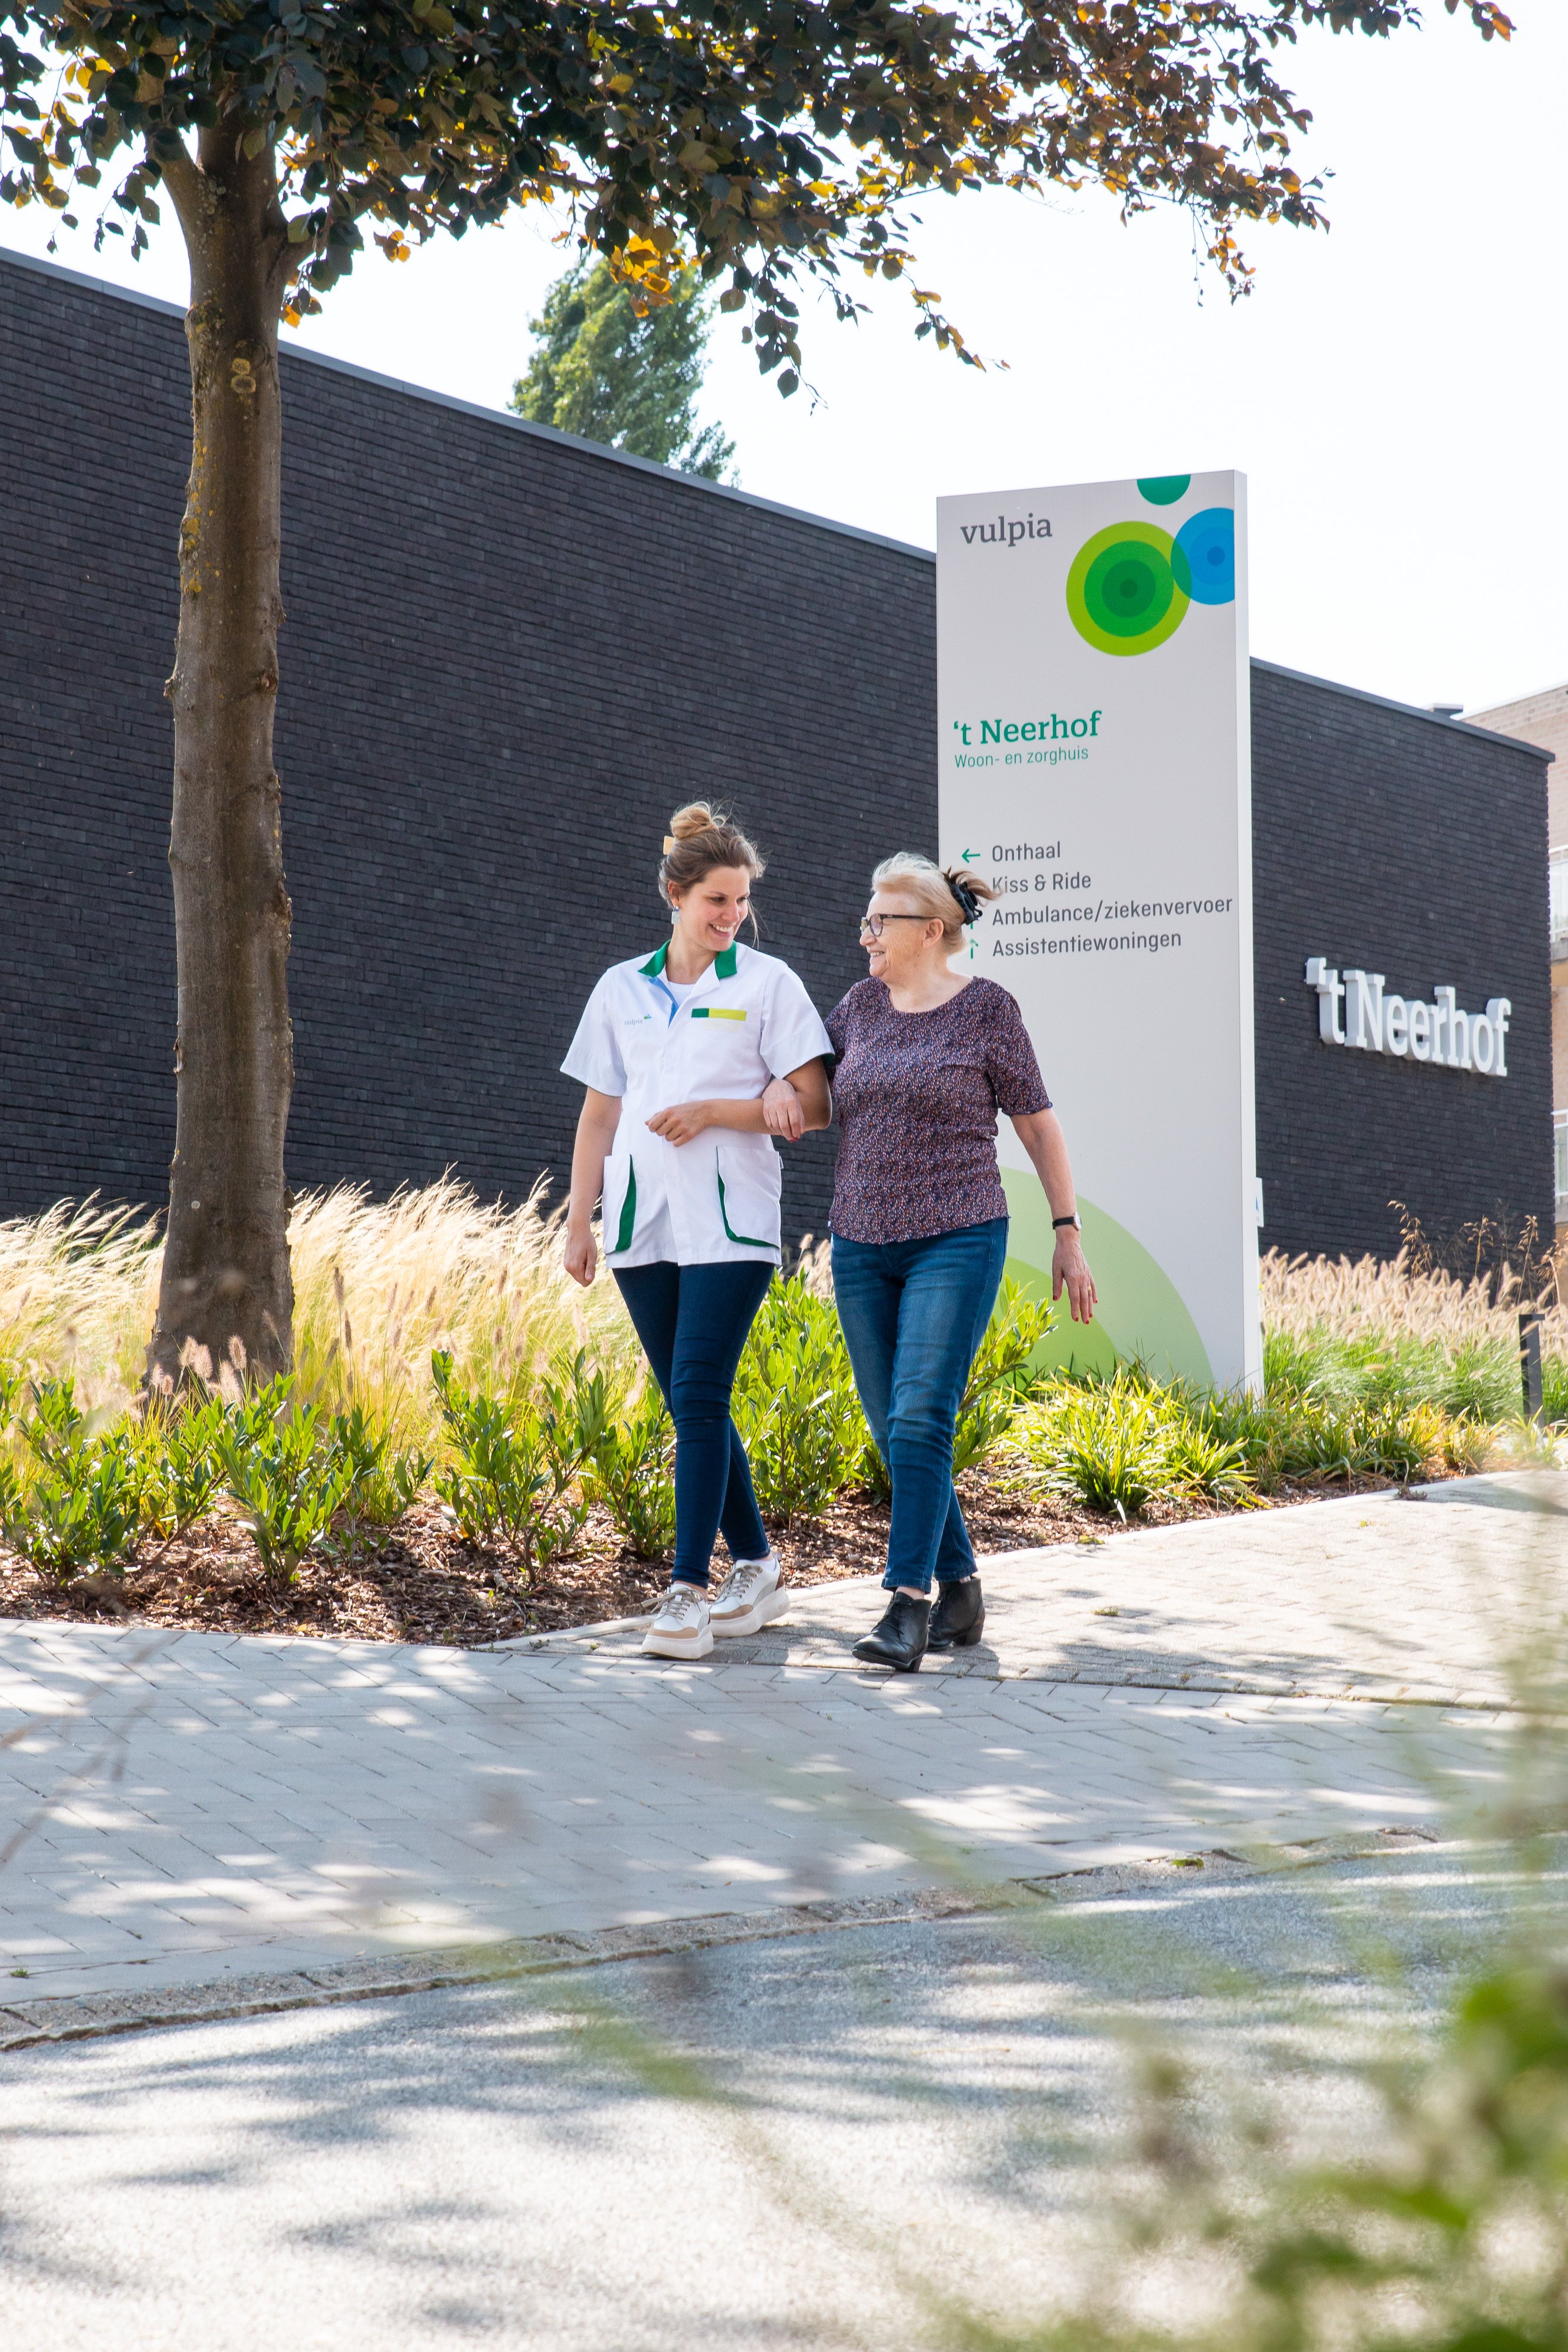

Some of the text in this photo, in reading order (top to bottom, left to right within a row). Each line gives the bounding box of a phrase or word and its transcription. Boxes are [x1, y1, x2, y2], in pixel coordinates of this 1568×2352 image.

[960, 512, 1053, 547] vulpia
[980, 709, 1102, 744] Neerhof
[954, 746, 1089, 769] Woon- en zorghuis
[992, 840, 1061, 863] Onthaal
[992, 872, 1091, 893] Kiss & Ride
[992, 898, 1233, 926] Ambulance/ziekenvervoer
[992, 931, 1181, 957] Assistentiewoningen
[1343, 969, 1512, 1077] Neerhof
